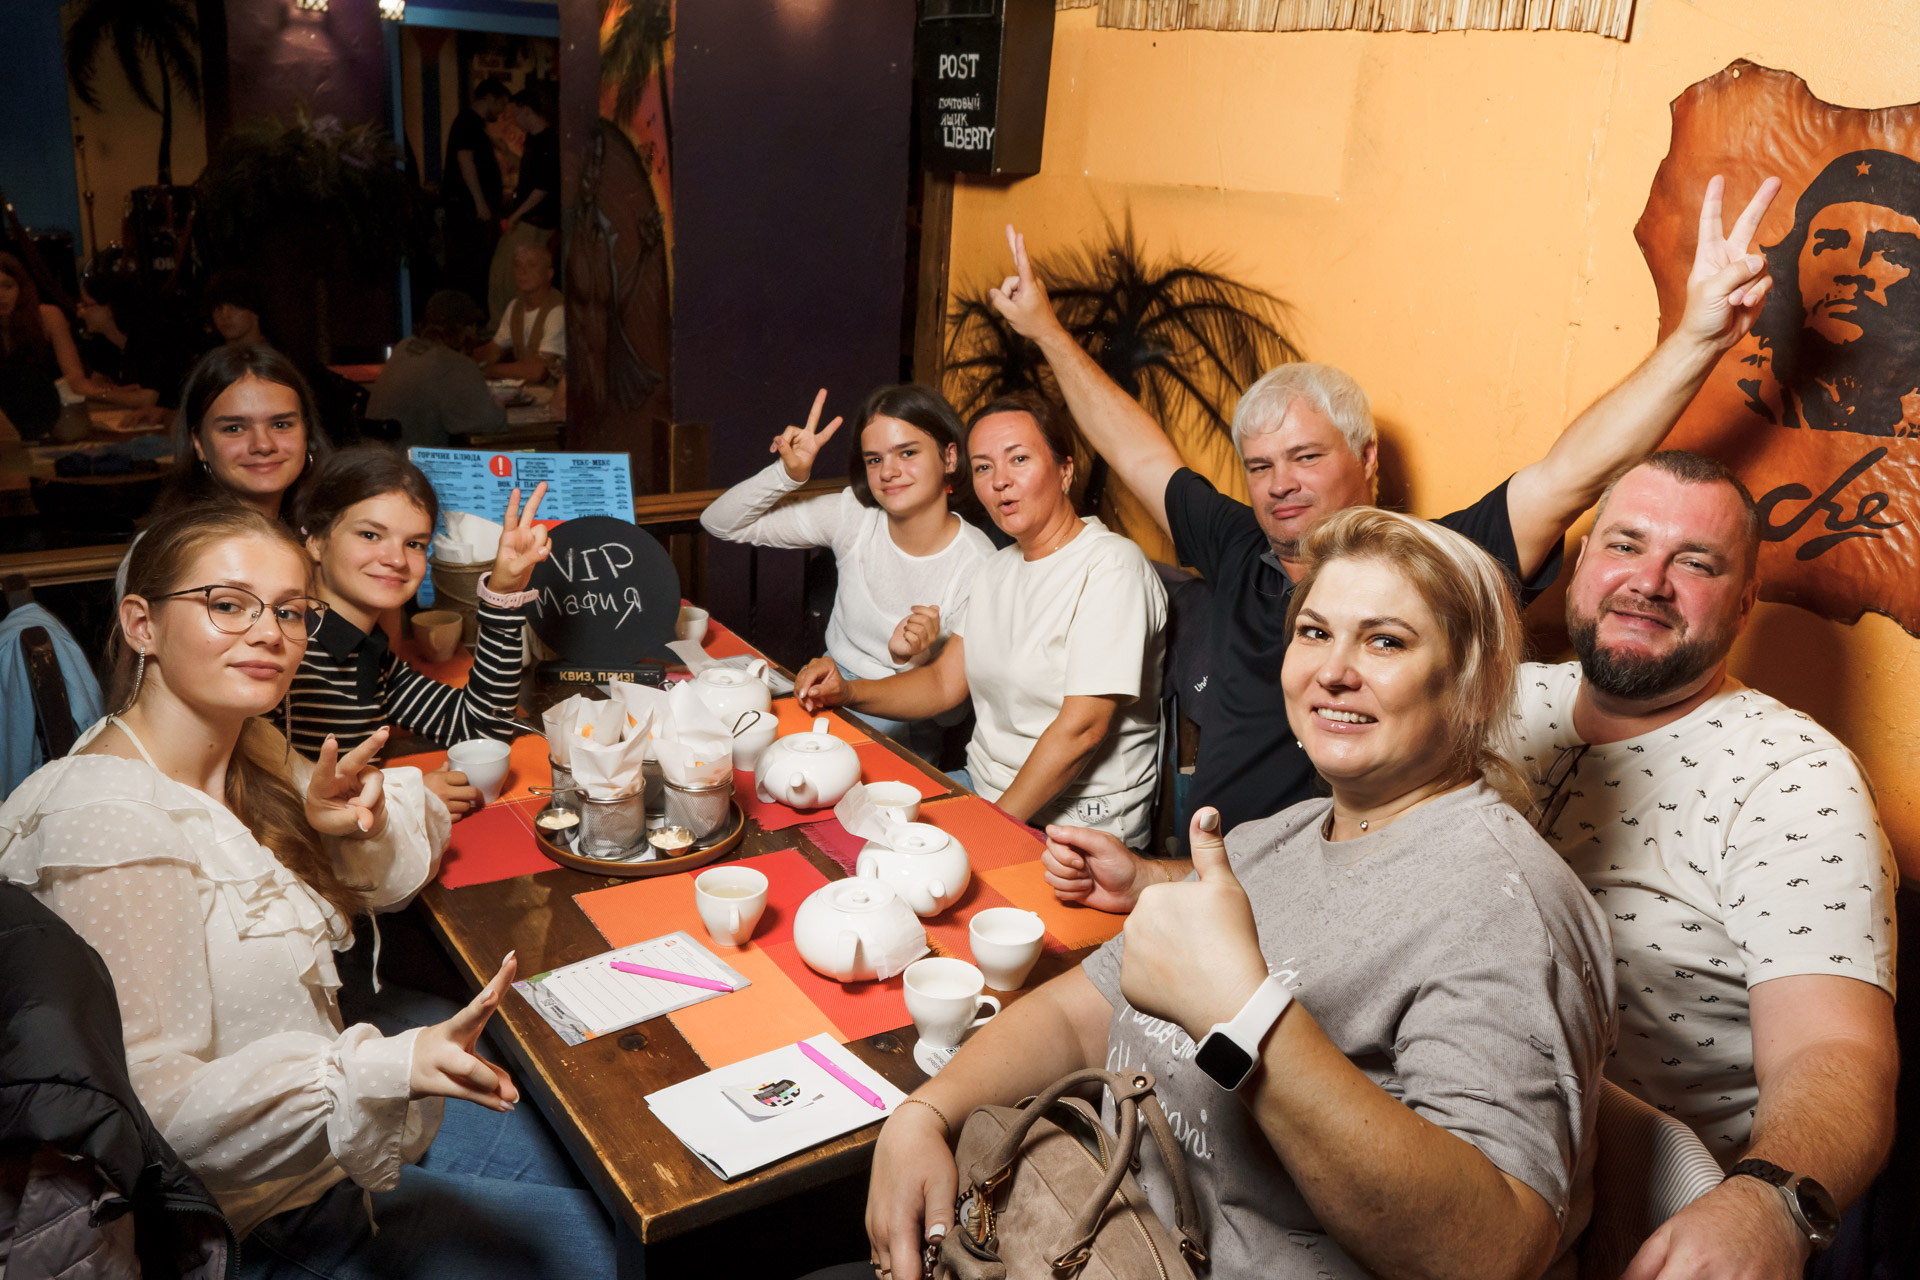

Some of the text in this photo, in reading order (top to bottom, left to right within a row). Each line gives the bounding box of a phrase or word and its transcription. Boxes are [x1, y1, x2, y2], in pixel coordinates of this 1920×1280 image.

[939, 53, 980, 79] POST
[943, 126, 996, 151] LIBERTY
[549, 542, 634, 583] VIP
[559, 671, 595, 683] КВИЗ,
